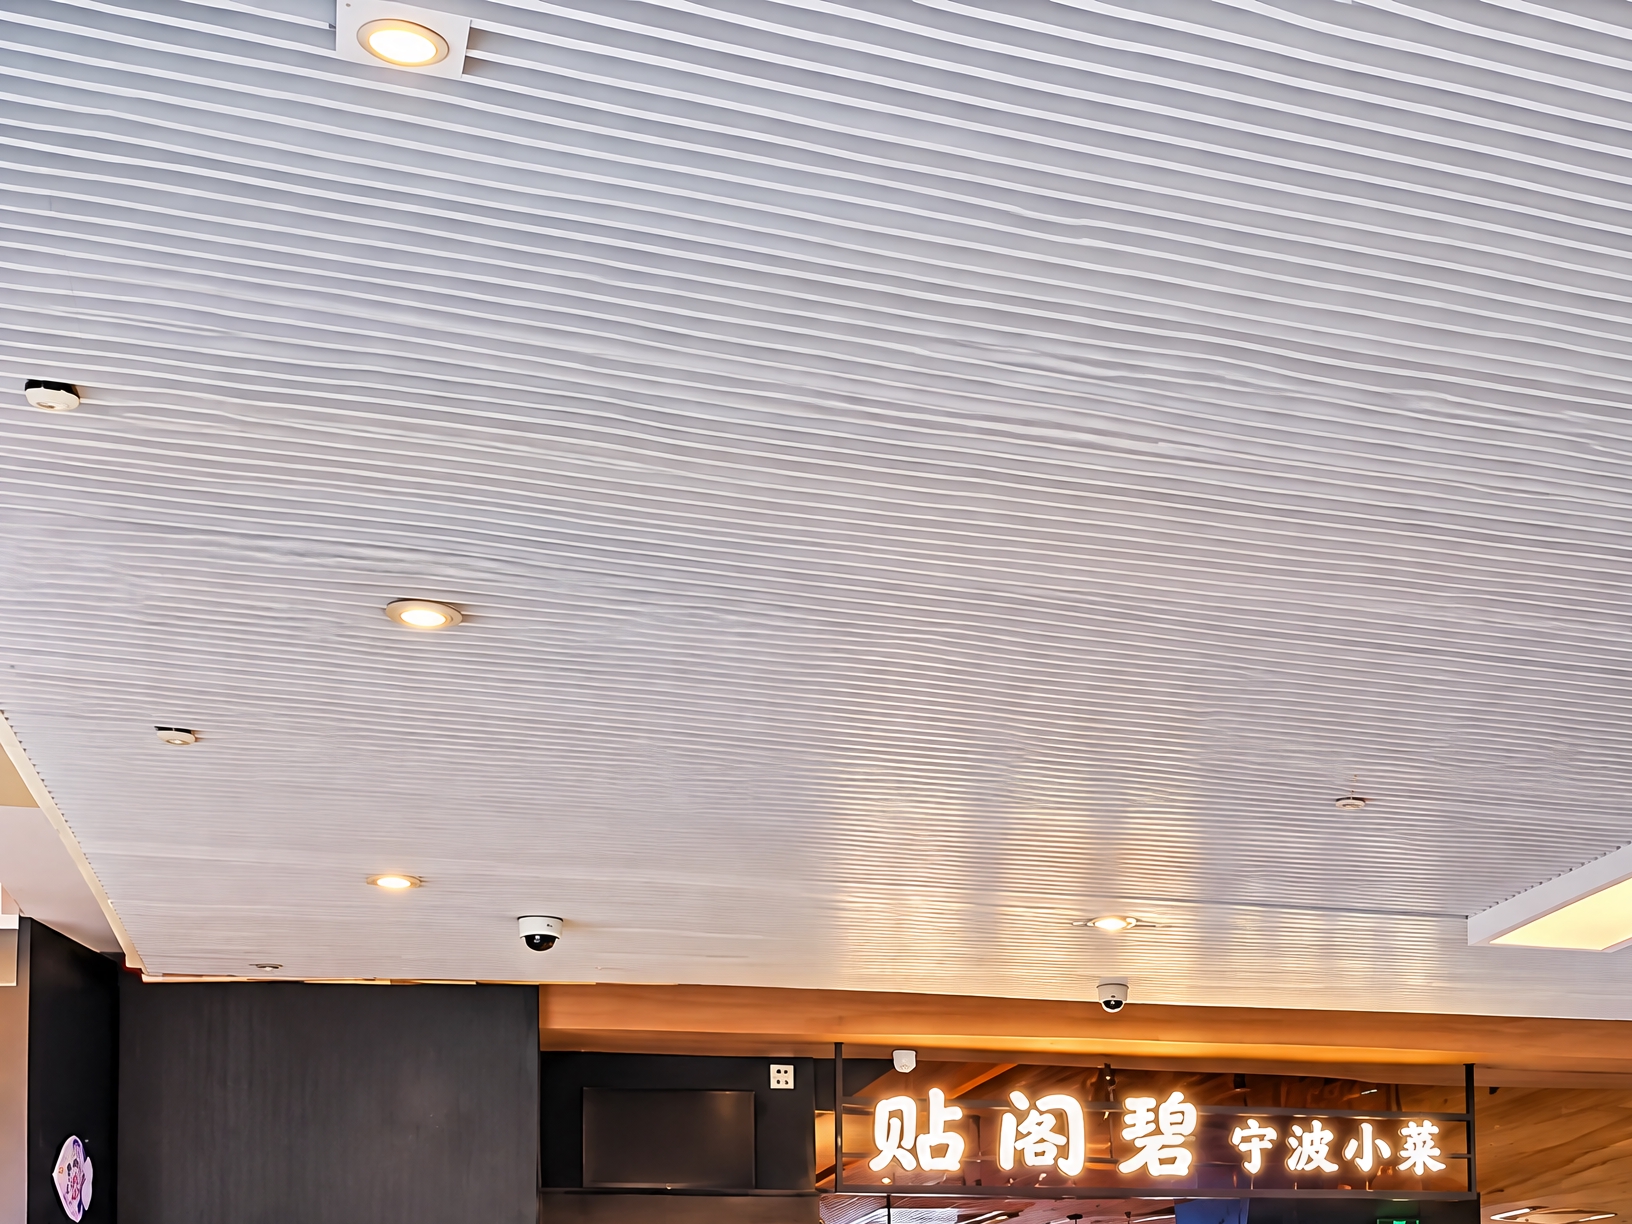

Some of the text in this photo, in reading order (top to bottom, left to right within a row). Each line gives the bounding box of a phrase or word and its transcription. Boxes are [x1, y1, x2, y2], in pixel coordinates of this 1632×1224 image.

[868, 1087, 1447, 1177] 贴阁碧 宁波小菜
